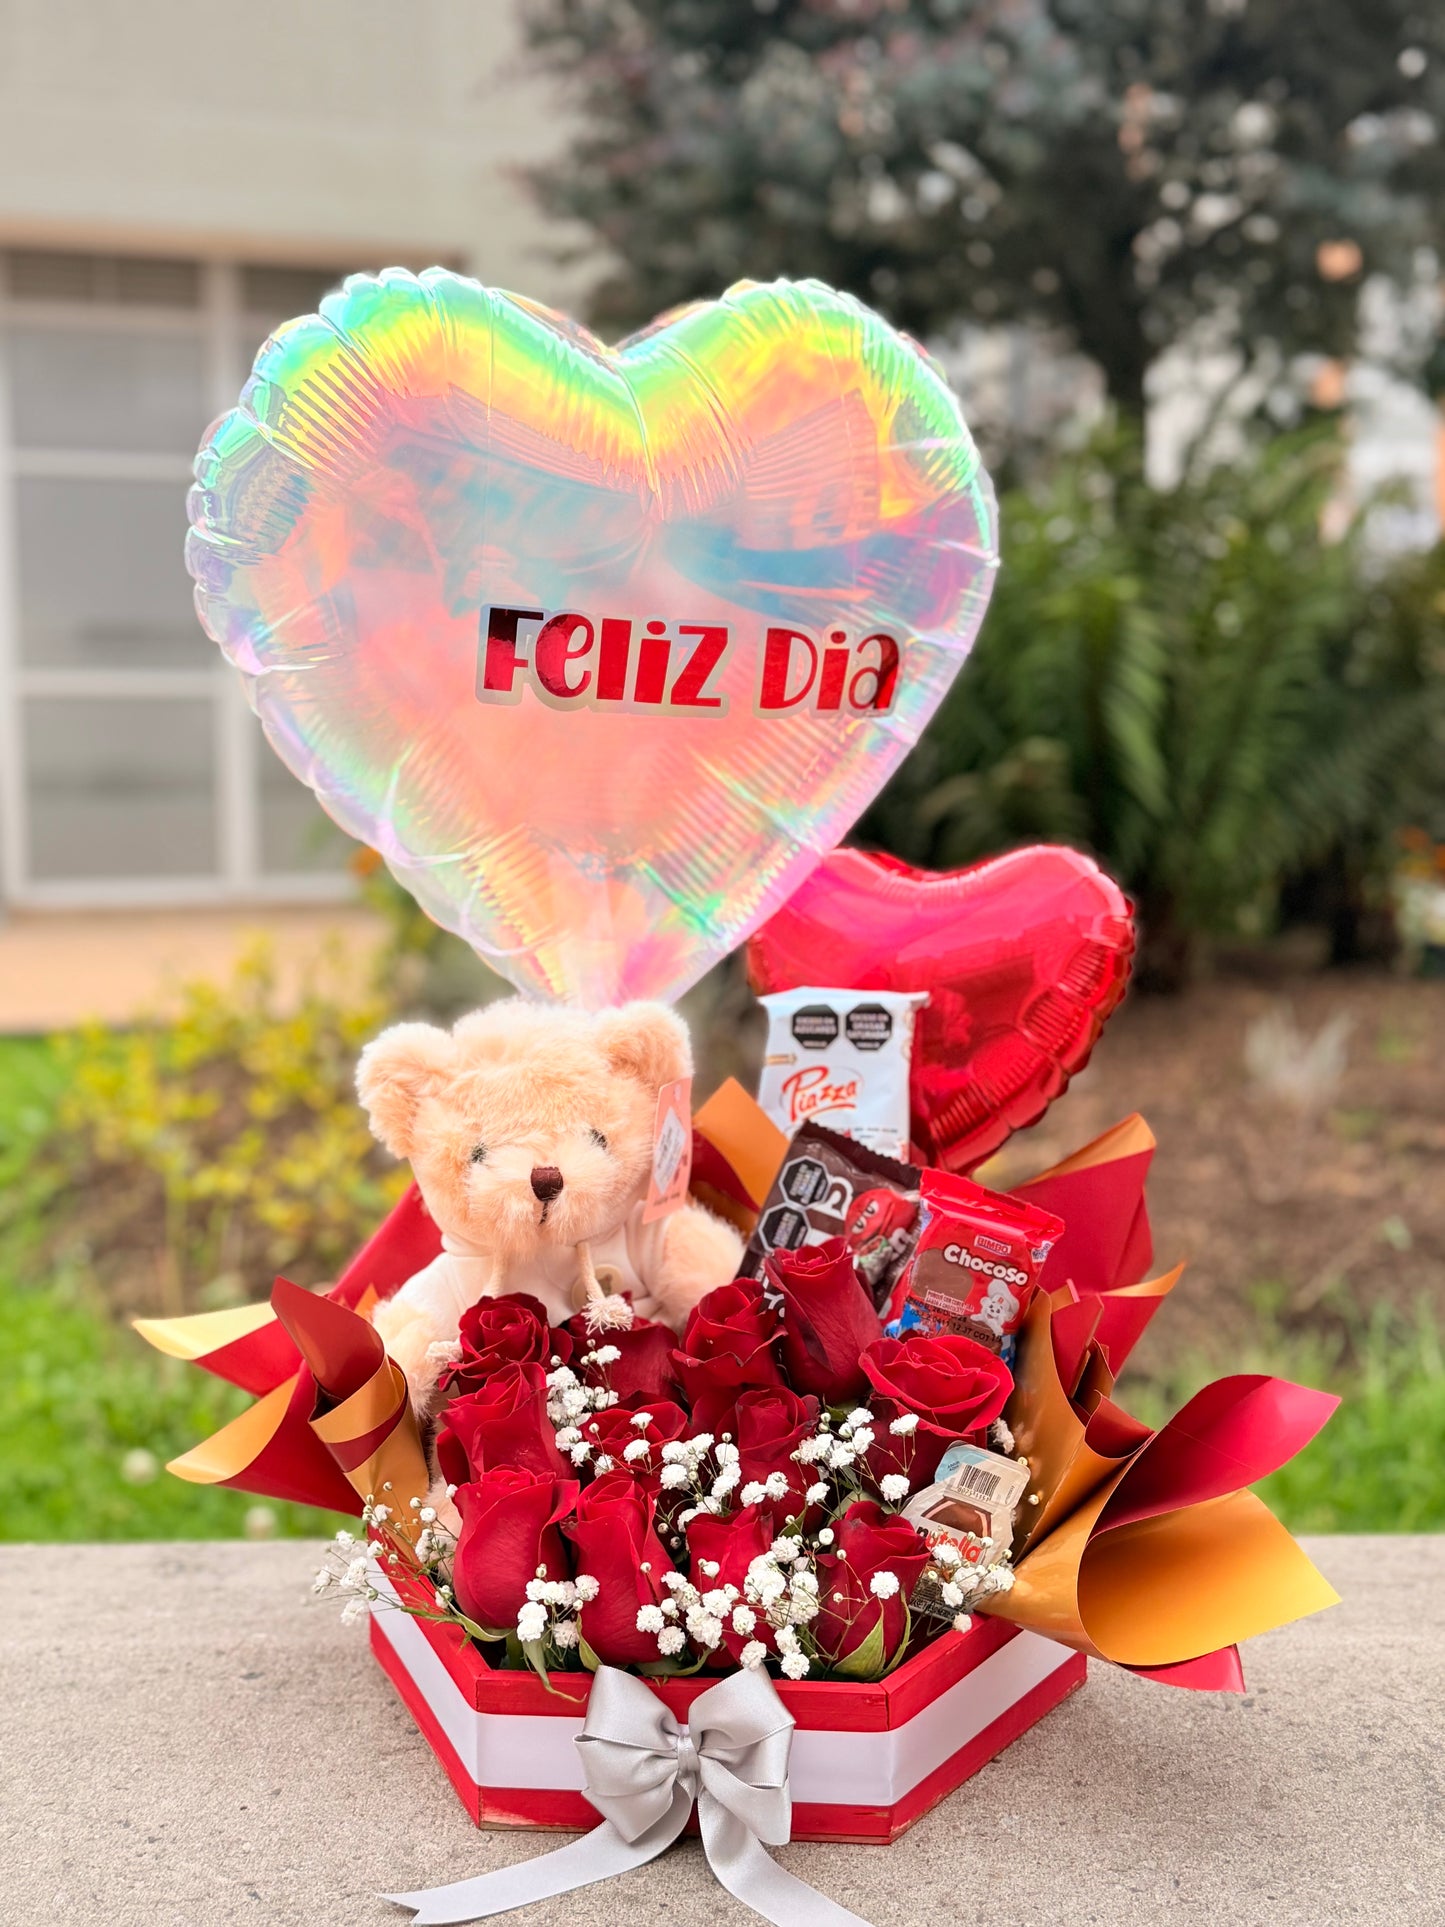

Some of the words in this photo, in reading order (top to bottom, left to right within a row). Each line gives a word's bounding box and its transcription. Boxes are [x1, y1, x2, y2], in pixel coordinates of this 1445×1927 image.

[782, 1066, 857, 1122] Piazza
[943, 1243, 1029, 1286] Chocoso
[977, 1237, 1009, 1254] BIMBO
